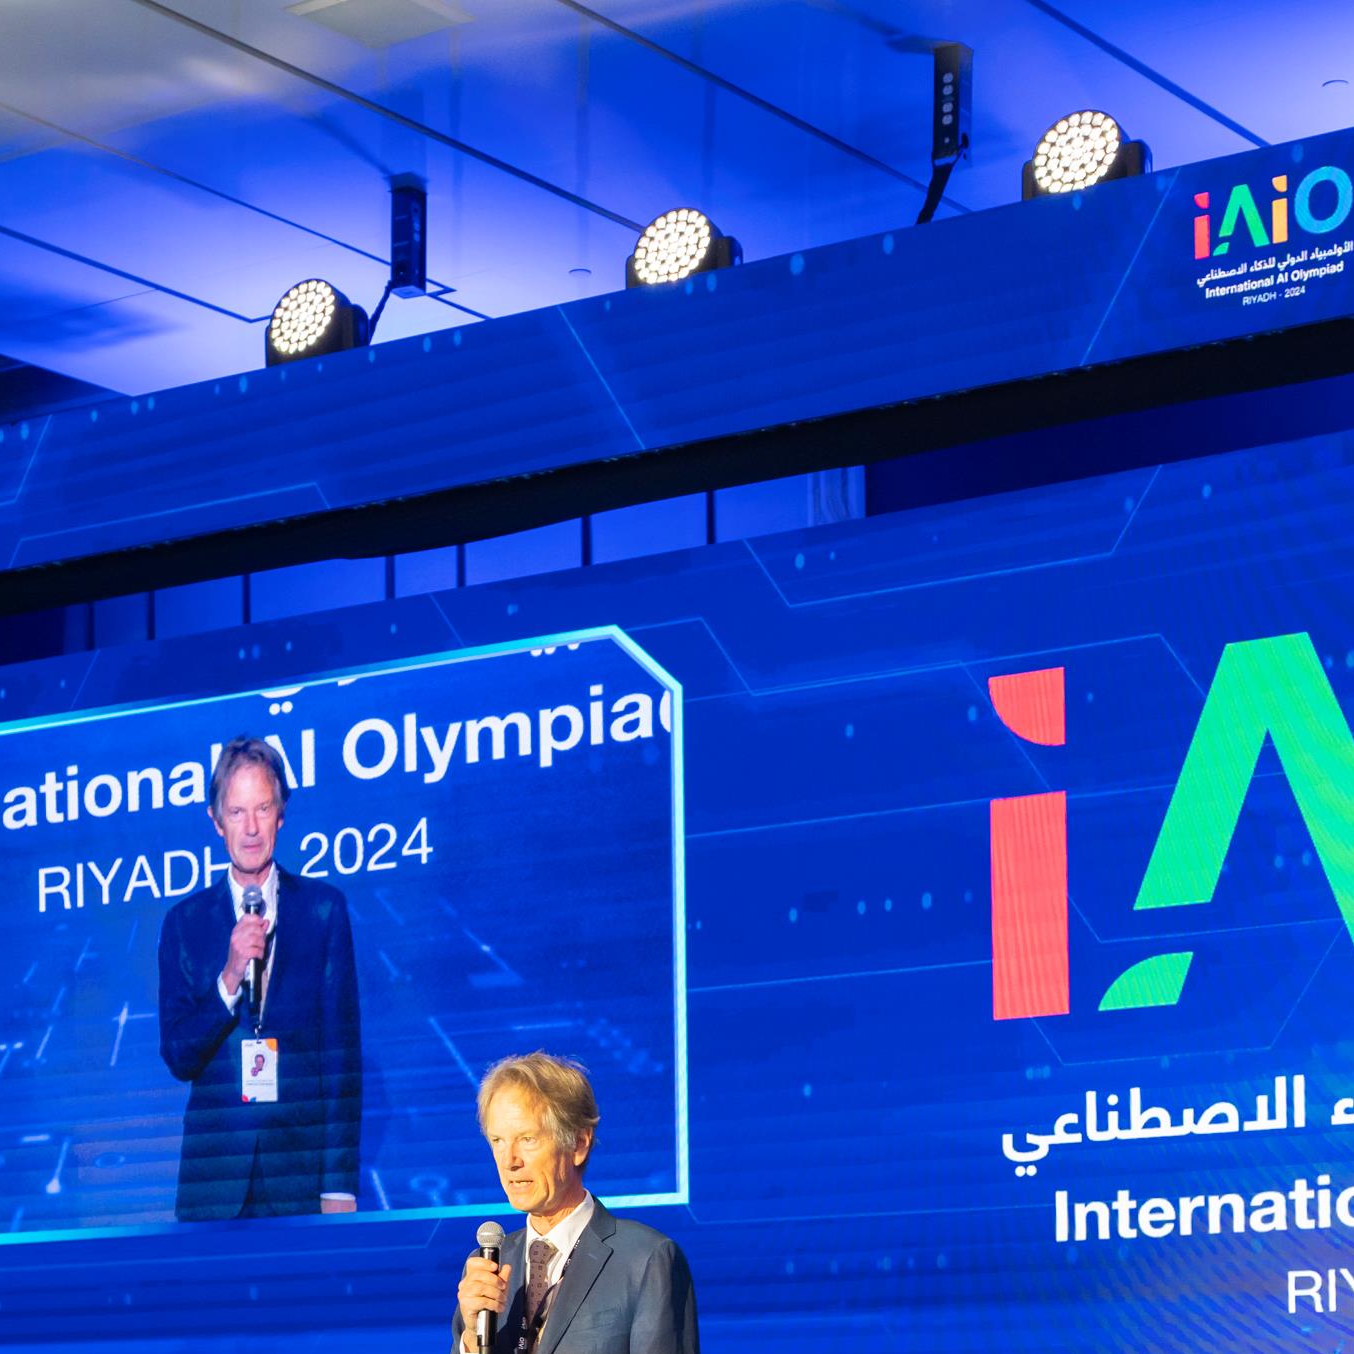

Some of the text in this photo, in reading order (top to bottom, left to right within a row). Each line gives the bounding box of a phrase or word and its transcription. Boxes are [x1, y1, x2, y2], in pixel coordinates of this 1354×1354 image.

[1205, 260, 1344, 299] International AI Olympiad
[1277, 250, 1308, 271] الدولي
[1242, 290, 1277, 306] RIYADH
[1284, 285, 1306, 299] 2024
[343, 685, 671, 779] Olympia
[300, 817, 433, 878] 2024
[1002, 1074, 1306, 1177] الاصطناعي
